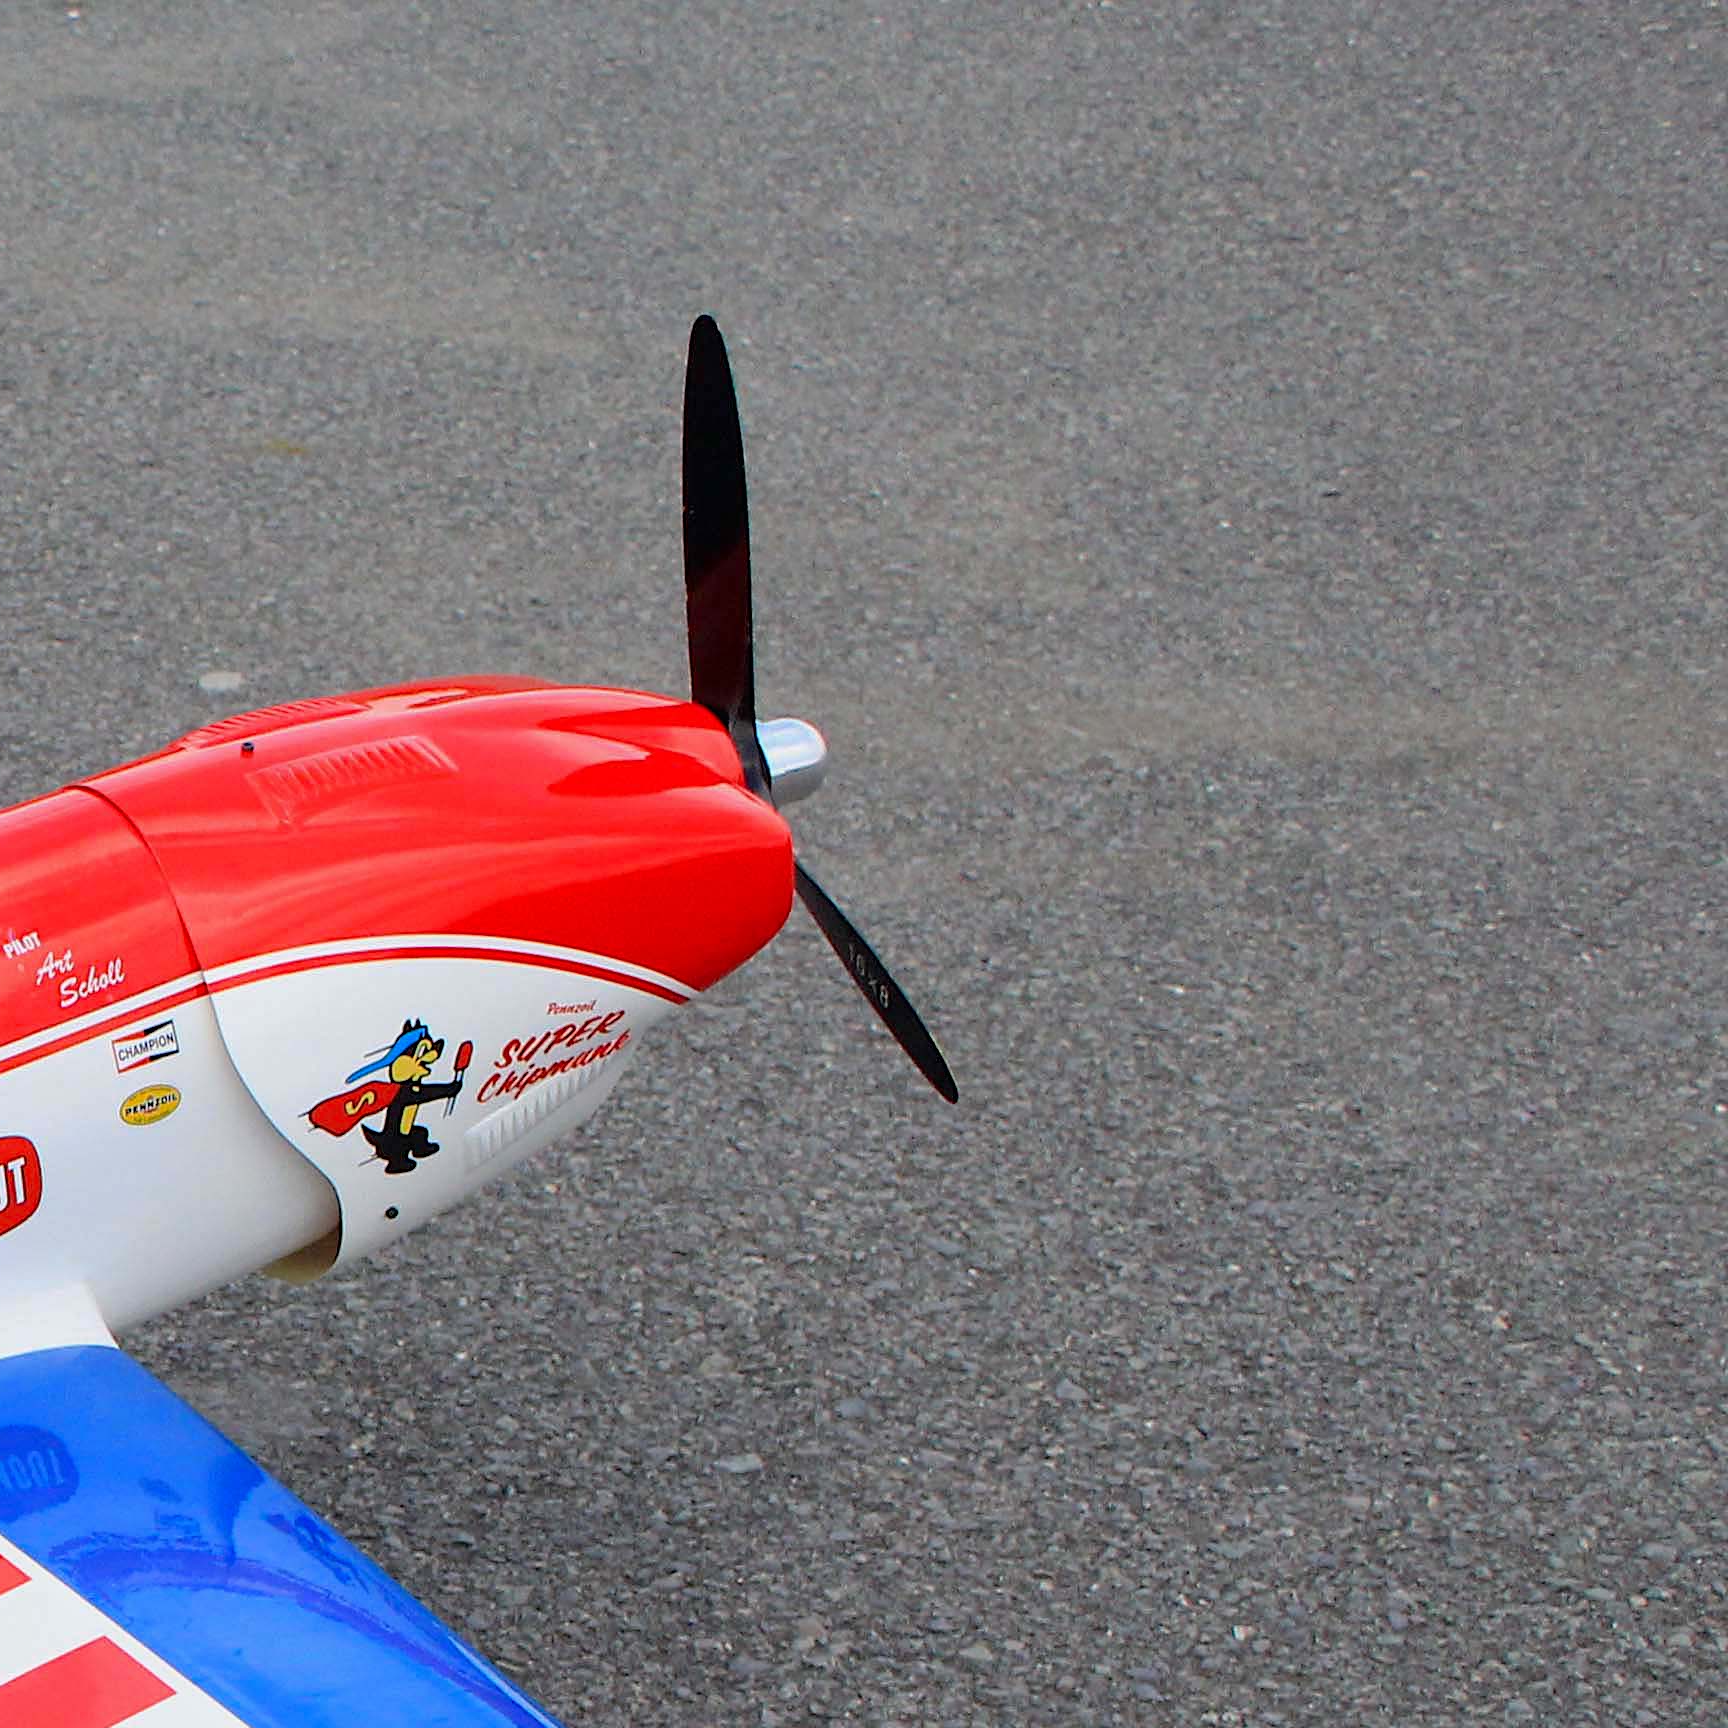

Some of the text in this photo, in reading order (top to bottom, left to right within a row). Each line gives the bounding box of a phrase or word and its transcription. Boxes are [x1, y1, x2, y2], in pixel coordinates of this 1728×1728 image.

[3, 931, 41, 959] PILOT
[36, 950, 74, 985] Art
[59, 957, 125, 1009] Scholl
[118, 1032, 174, 1062] CHAMPION
[494, 1010, 625, 1069] SUPER
[476, 1028, 632, 1104] Chipmunk
[125, 1093, 178, 1118] PENNZOIL
